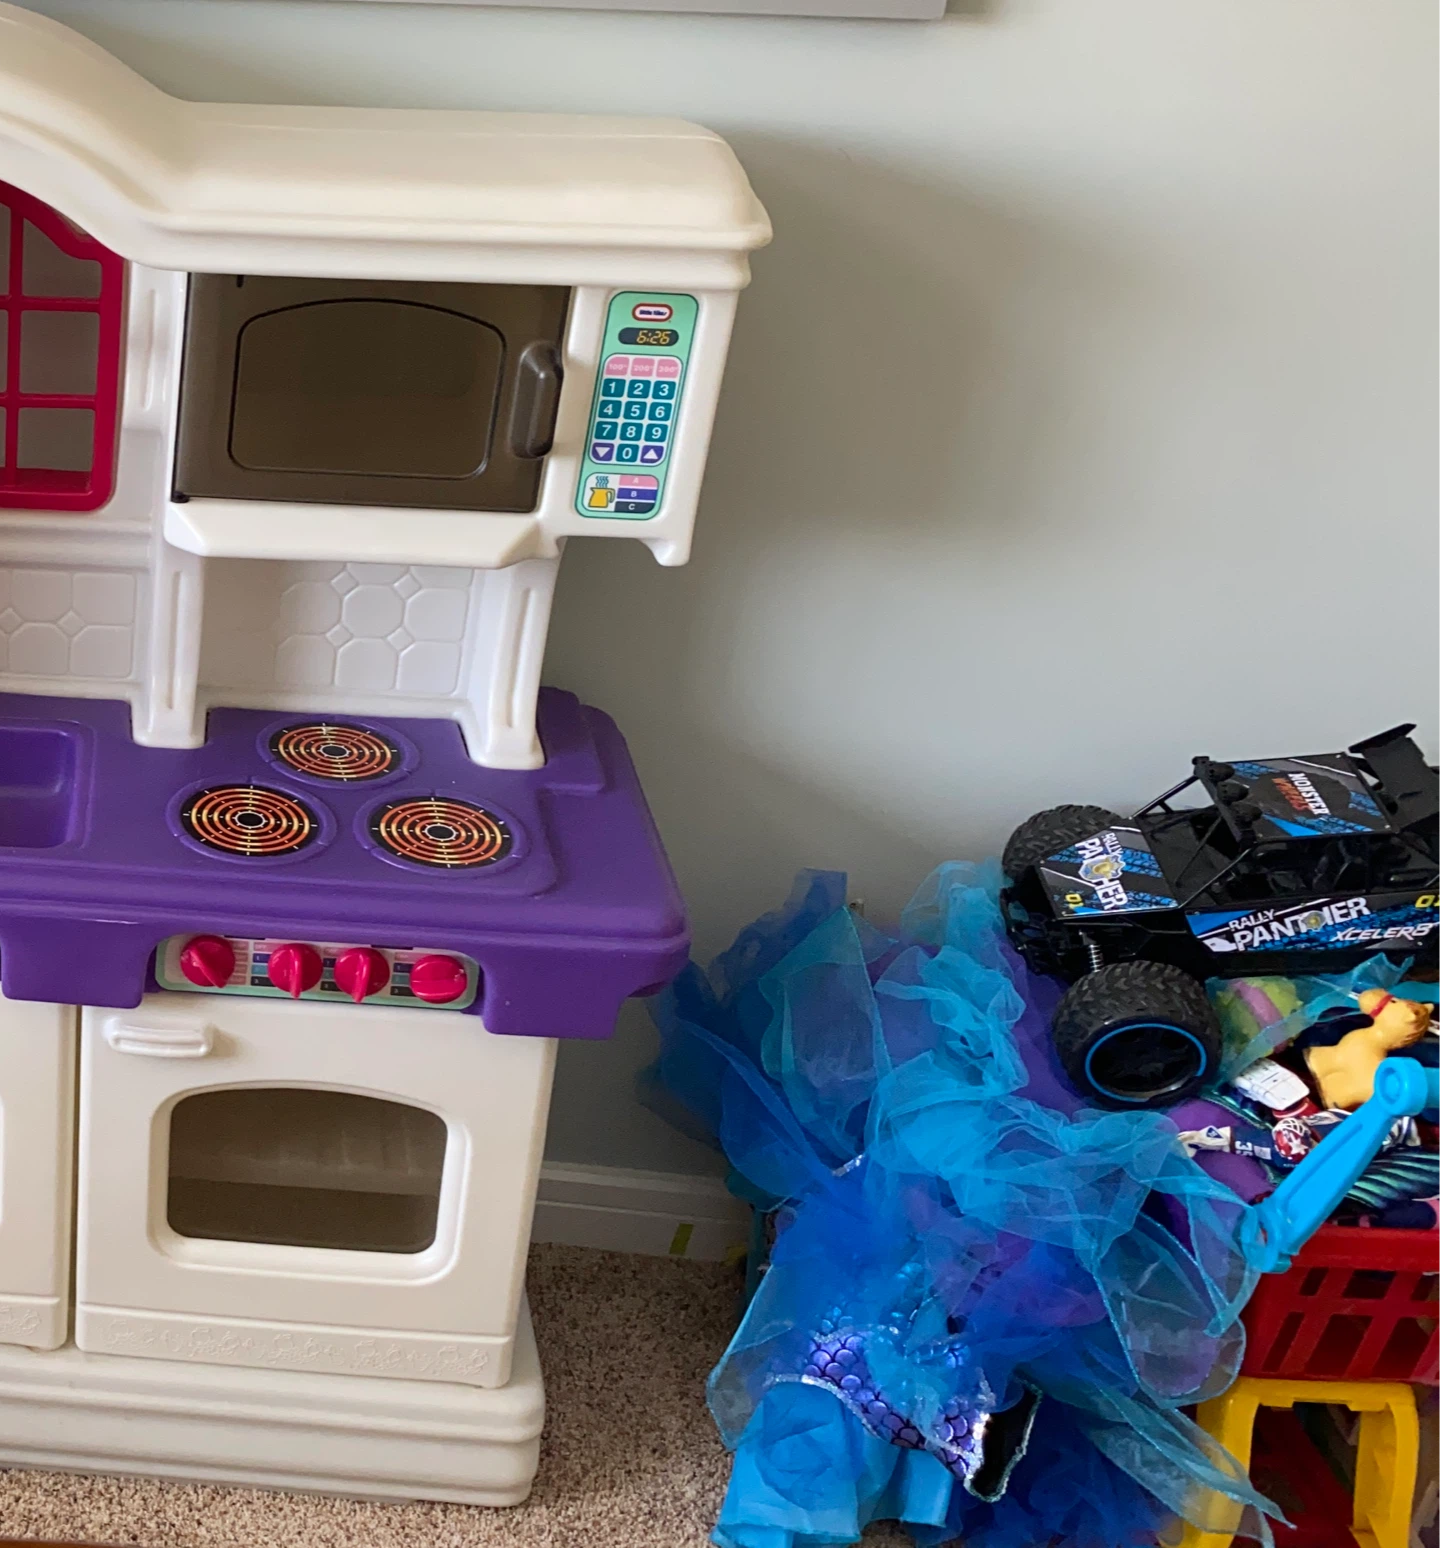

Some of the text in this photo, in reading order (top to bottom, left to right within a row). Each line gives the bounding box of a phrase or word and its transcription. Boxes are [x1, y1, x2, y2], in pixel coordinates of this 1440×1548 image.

[636, 330, 672, 345] 6:26
[609, 381, 669, 396] 1 2 3
[603, 404, 665, 418] 4 5 6
[602, 424, 662, 439] 7 8 9
[622, 447, 632, 459] 0
[628, 503, 635, 511] C
[1287, 773, 1331, 816] MONSTER
[1101, 832, 1124, 855] RALLY
[1228, 908, 1276, 932] RALLY
